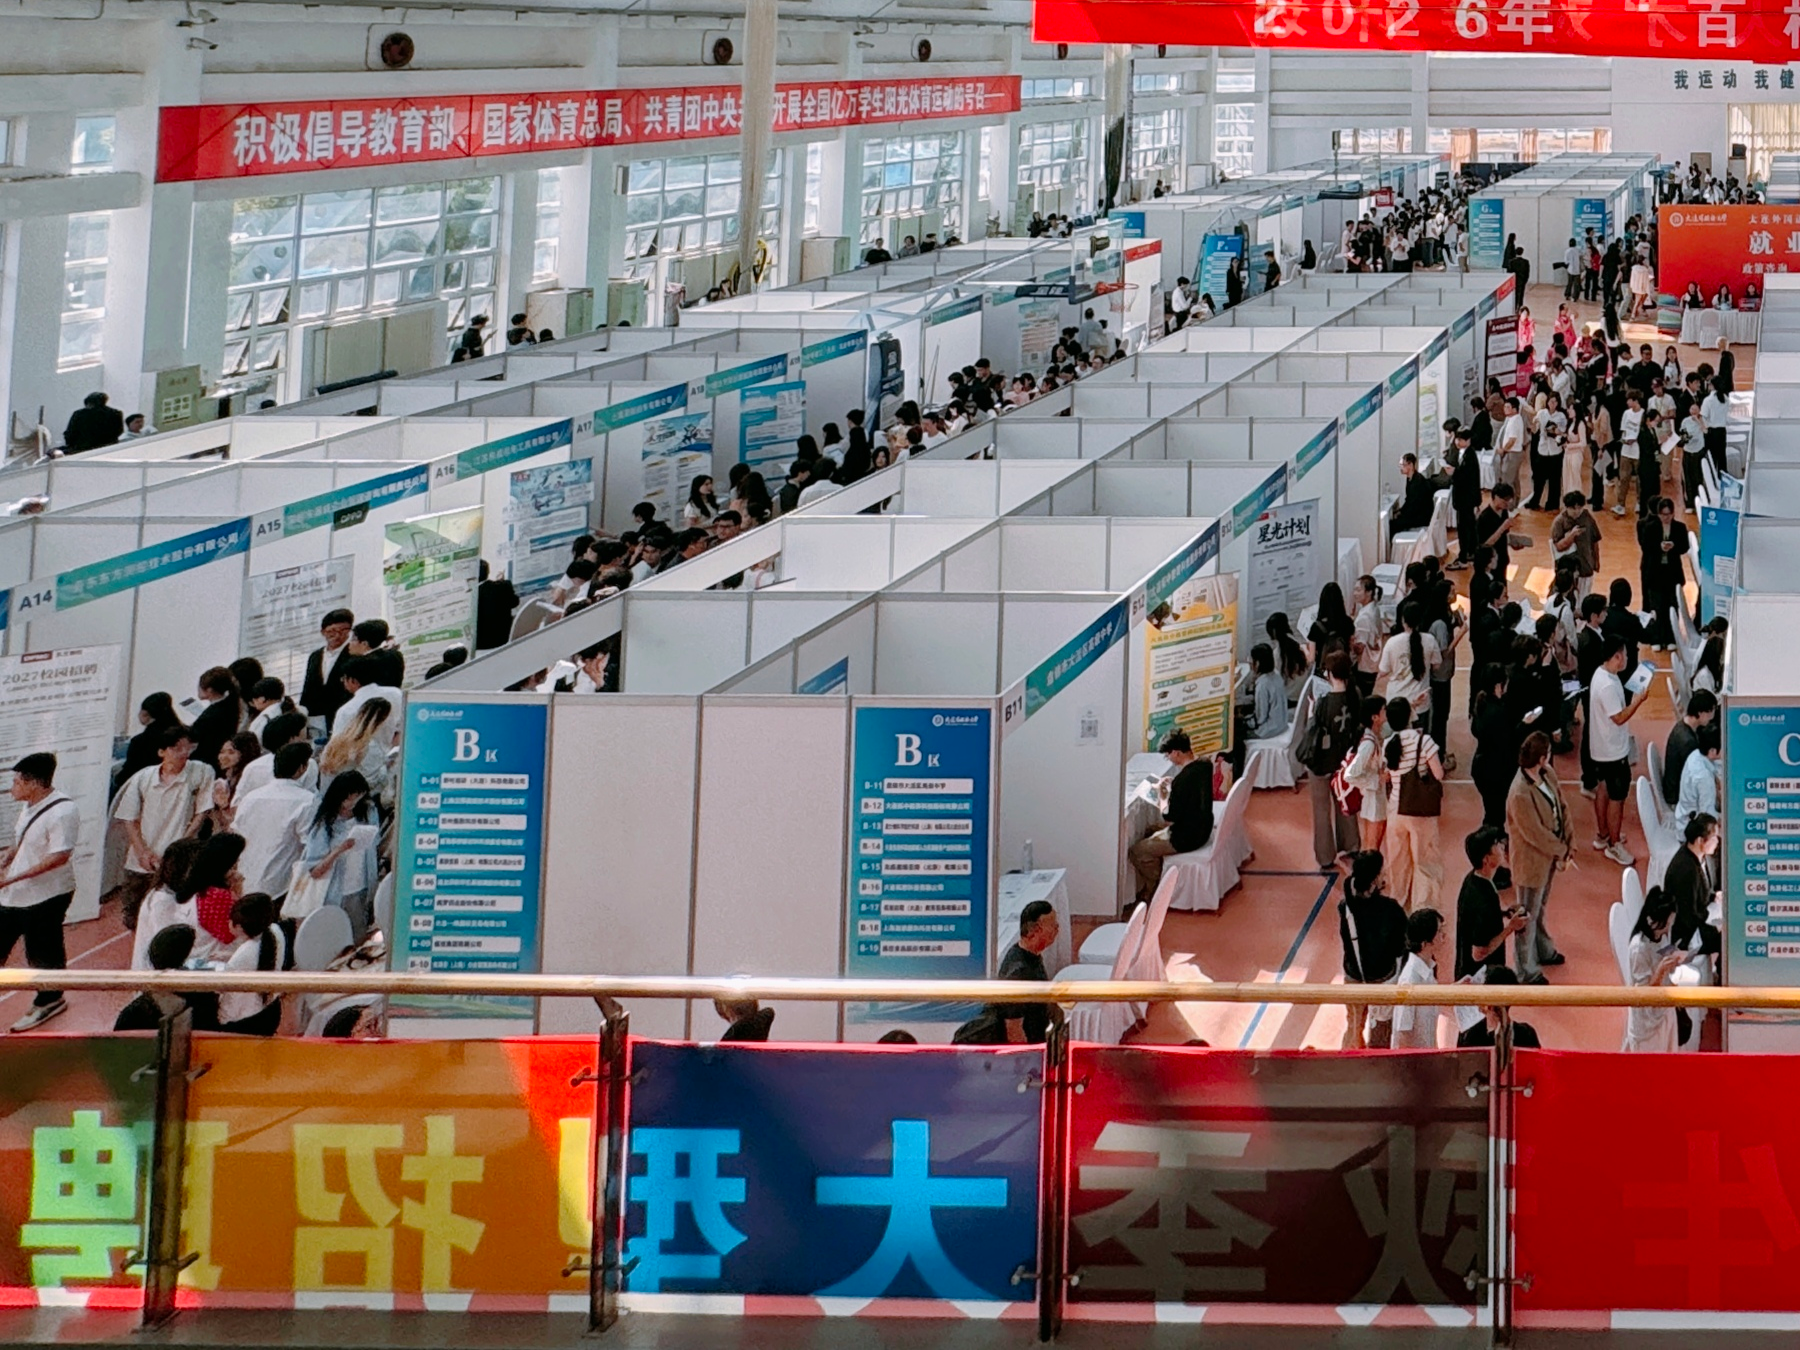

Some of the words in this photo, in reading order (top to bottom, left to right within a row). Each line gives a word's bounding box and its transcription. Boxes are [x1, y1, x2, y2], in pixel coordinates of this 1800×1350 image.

[1674, 68, 1738, 90] 我运动
[435, 463, 456, 482] A16
[256, 518, 281, 537] A15
[1257, 515, 1310, 545] 星光计划
[19, 589, 53, 613] A14
[1005, 695, 1024, 724] B11
